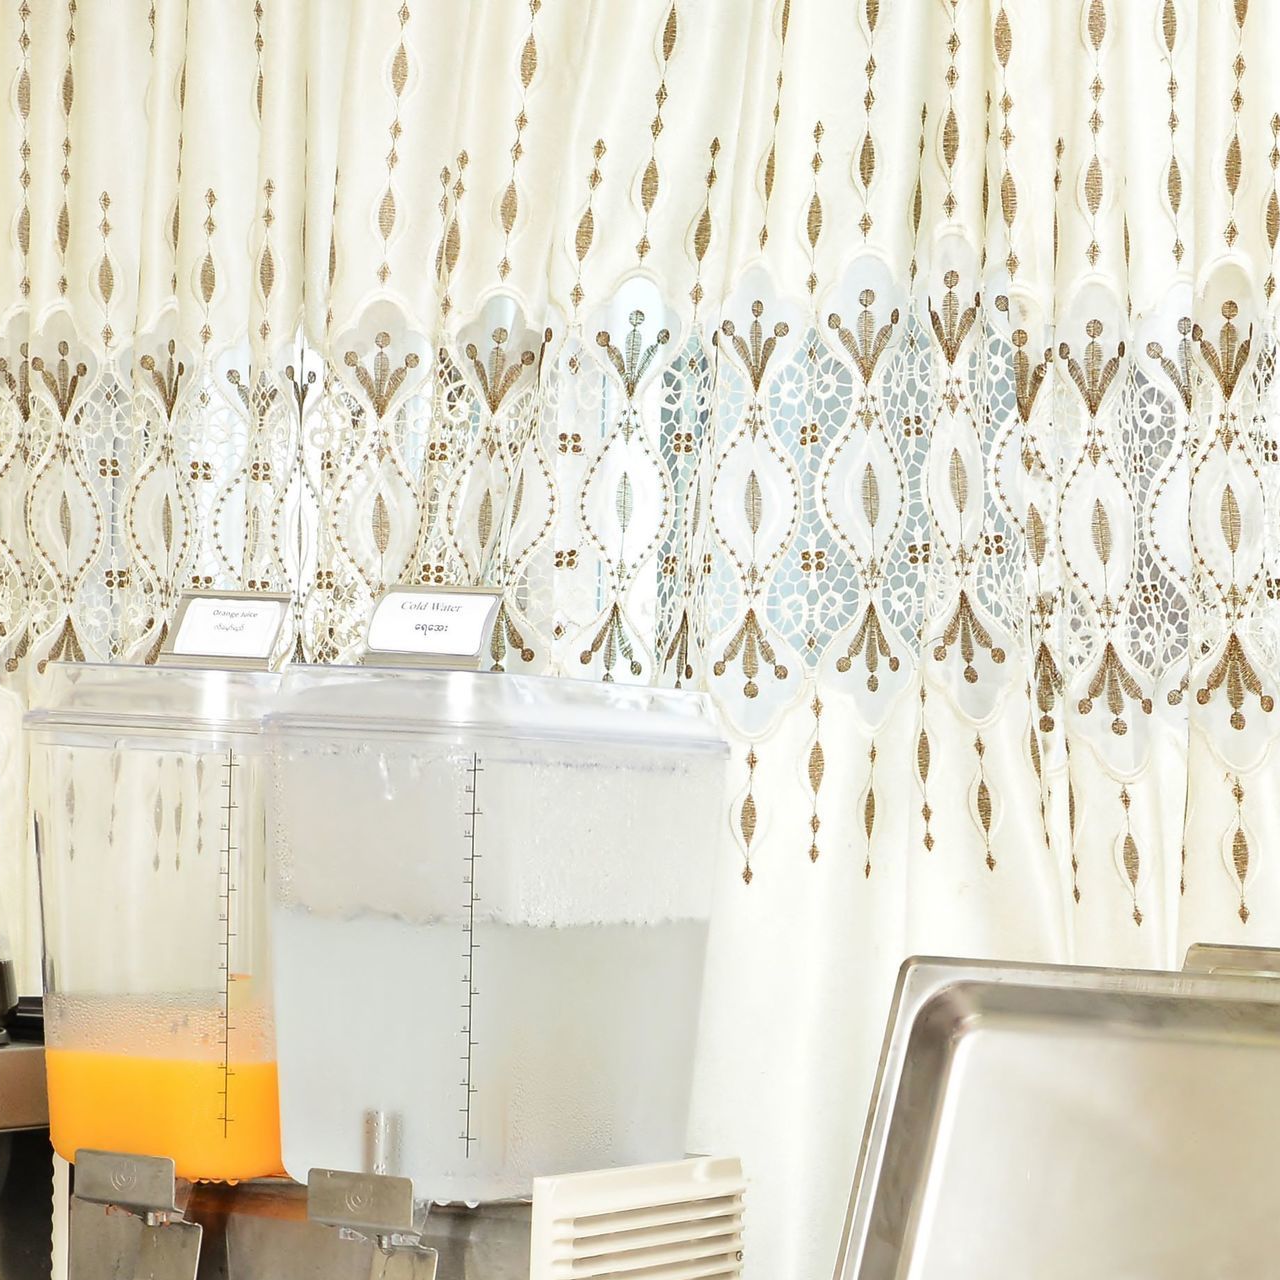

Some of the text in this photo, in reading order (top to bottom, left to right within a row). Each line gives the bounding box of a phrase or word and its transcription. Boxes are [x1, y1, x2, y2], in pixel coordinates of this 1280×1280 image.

[400, 600, 463, 613] Cold Water
[212, 609, 240, 619] Orange
